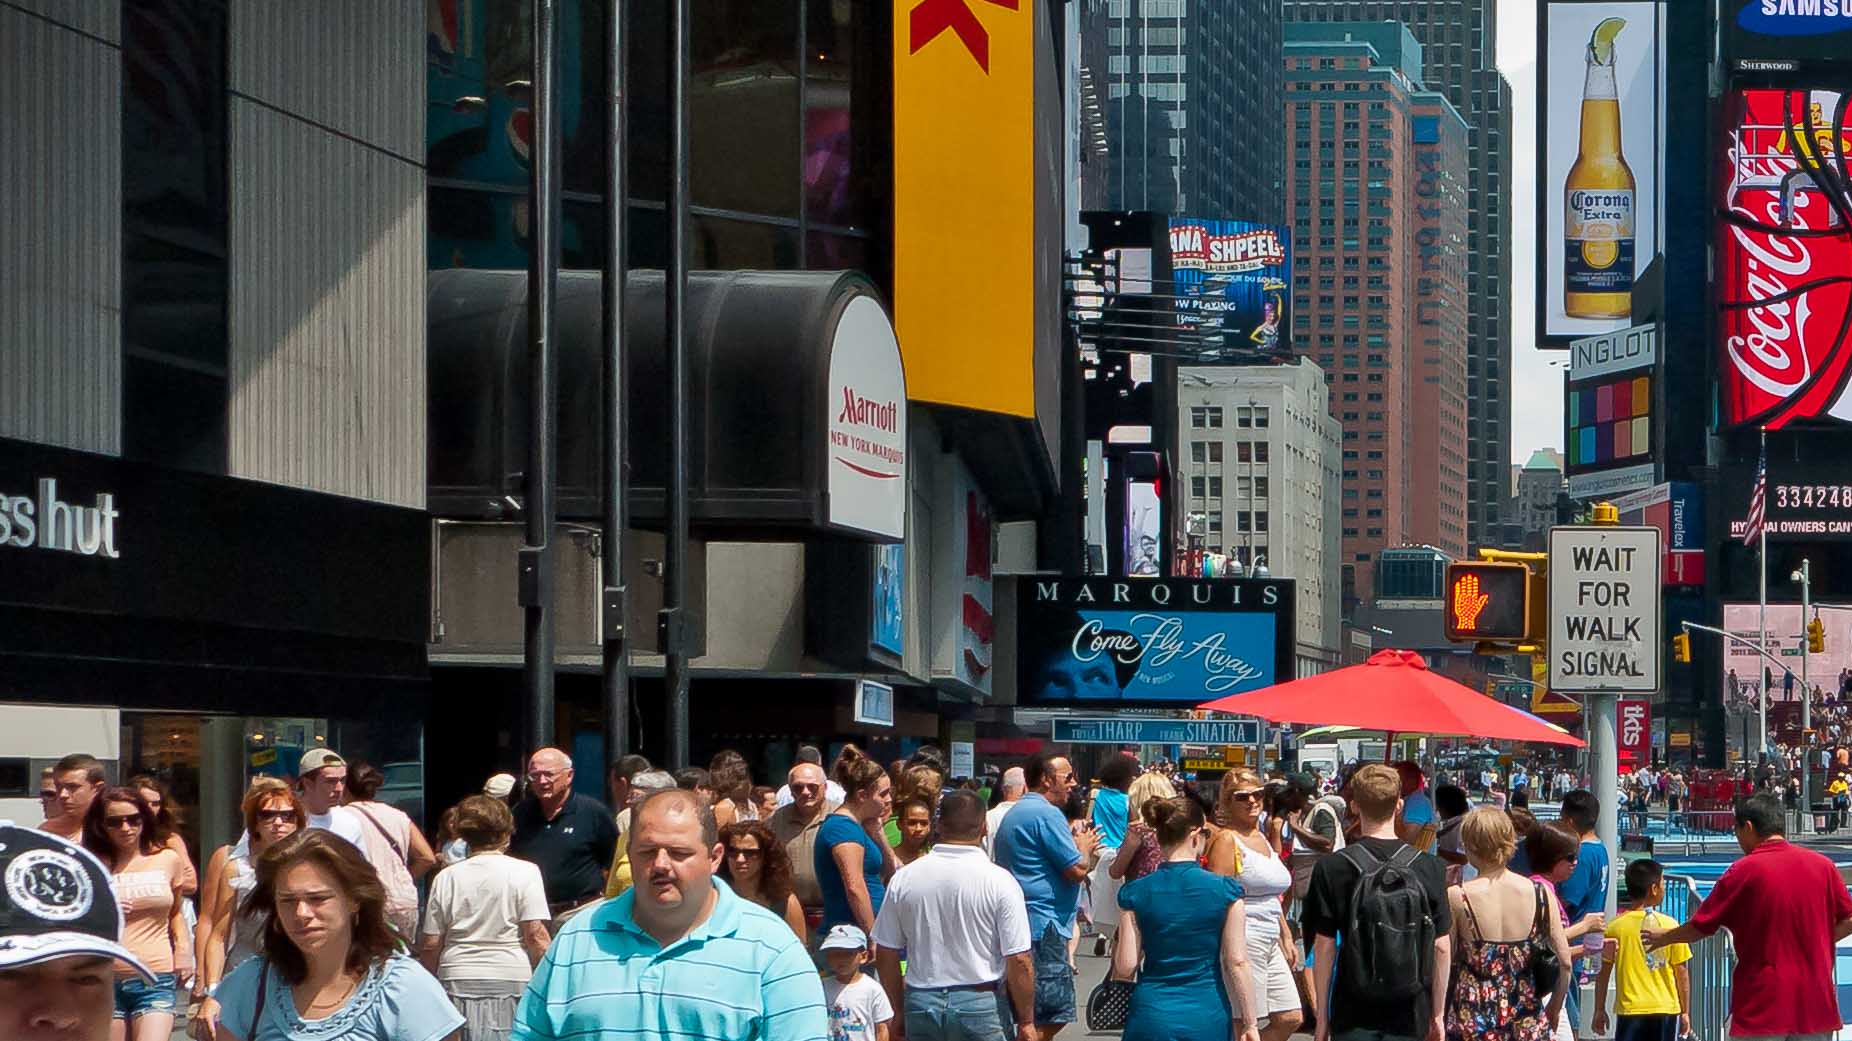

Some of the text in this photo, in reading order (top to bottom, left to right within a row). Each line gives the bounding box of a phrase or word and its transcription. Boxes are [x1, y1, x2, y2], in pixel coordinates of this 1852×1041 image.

[1739, 60, 1793, 71] SHERWOOD
[1571, 190, 1630, 213] Corona
[1584, 209, 1622, 221] Extra
[1209, 234, 1281, 262] SHPEEL
[1571, 328, 1656, 370] INGLOT
[839, 386, 897, 434] Marriott
[831, 430, 849, 447] NEW
[850, 437, 872, 454] YORK
[38, 478, 120, 559] hut
[1673, 498, 1684, 548] Travelex
[1780, 521, 1826, 534] OWNERS
[1572, 546, 1637, 572] WAIT
[1037, 581, 1278, 605] MARQUIS
[1578, 581, 1631, 607] FOR
[1566, 615, 1642, 642] WALK
[1072, 613, 1263, 692] Come Fly Away
[1561, 651, 1645, 677] SIGNAL
[1097, 721, 1143, 740] THARP
[1186, 722, 1246, 742] SINATRA
[1623, 704, 1645, 746] tkts
